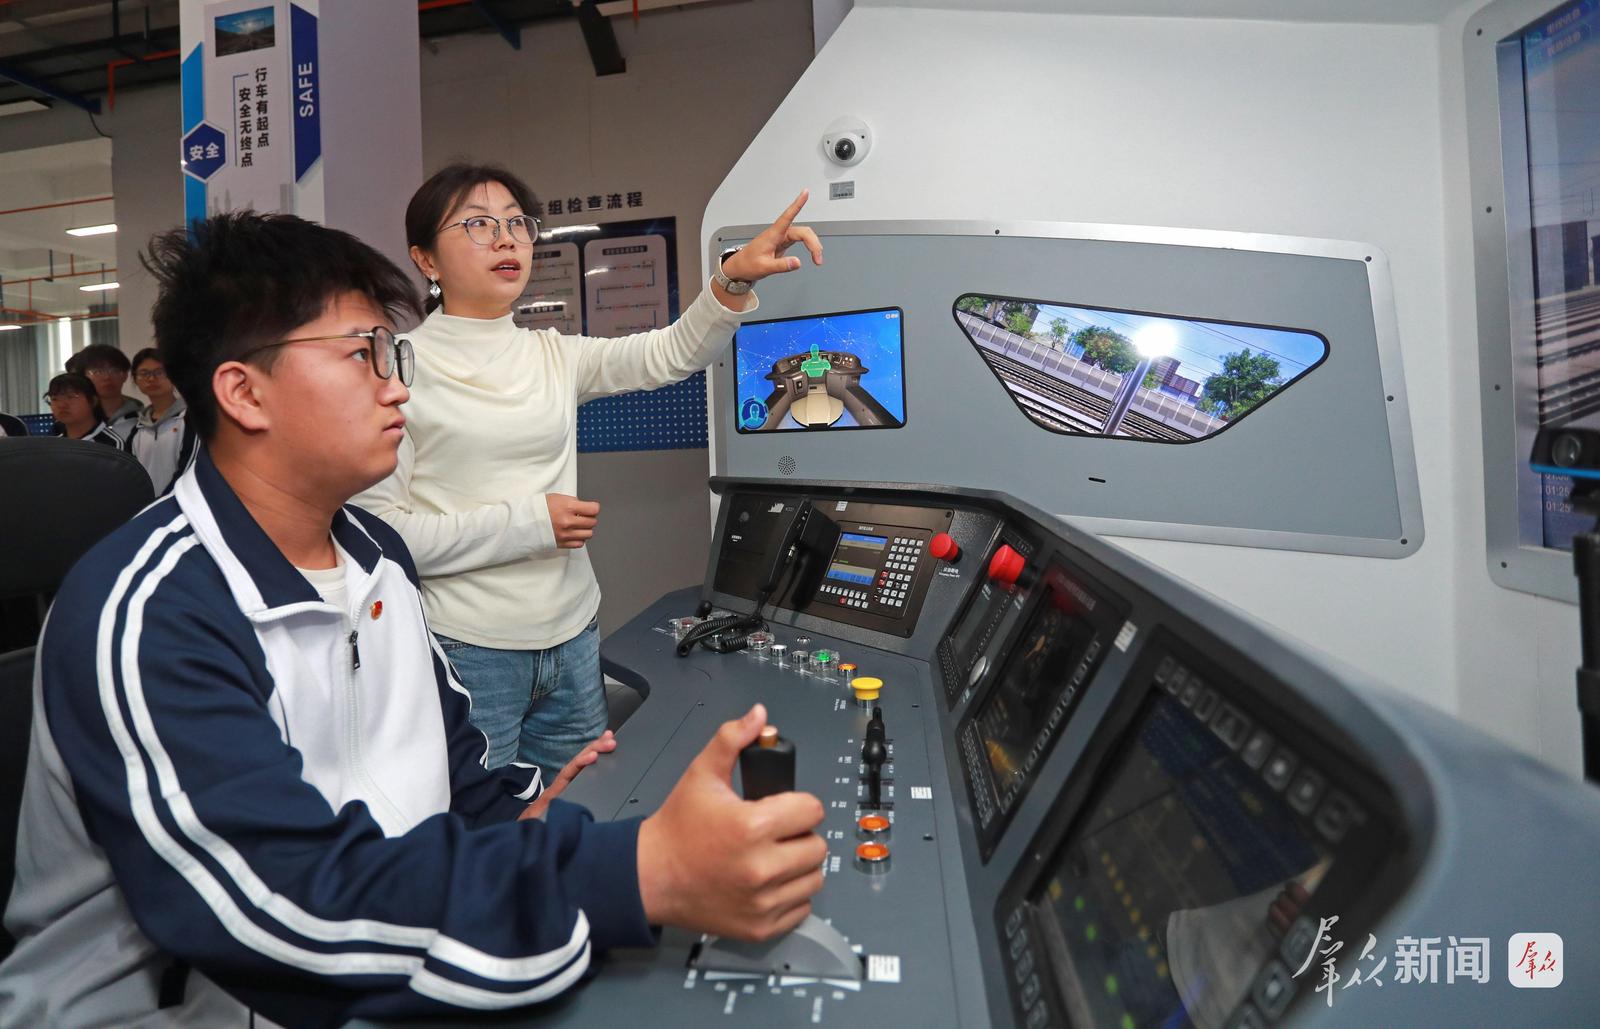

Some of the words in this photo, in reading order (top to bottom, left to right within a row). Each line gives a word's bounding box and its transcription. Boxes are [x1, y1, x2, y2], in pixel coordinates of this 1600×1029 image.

[255, 67, 270, 149] 行车有起点
[298, 62, 314, 118] SAFE
[189, 142, 220, 162] 安全
[238, 87, 253, 168] 安全无终点
[535, 191, 643, 216] 组检查流程
